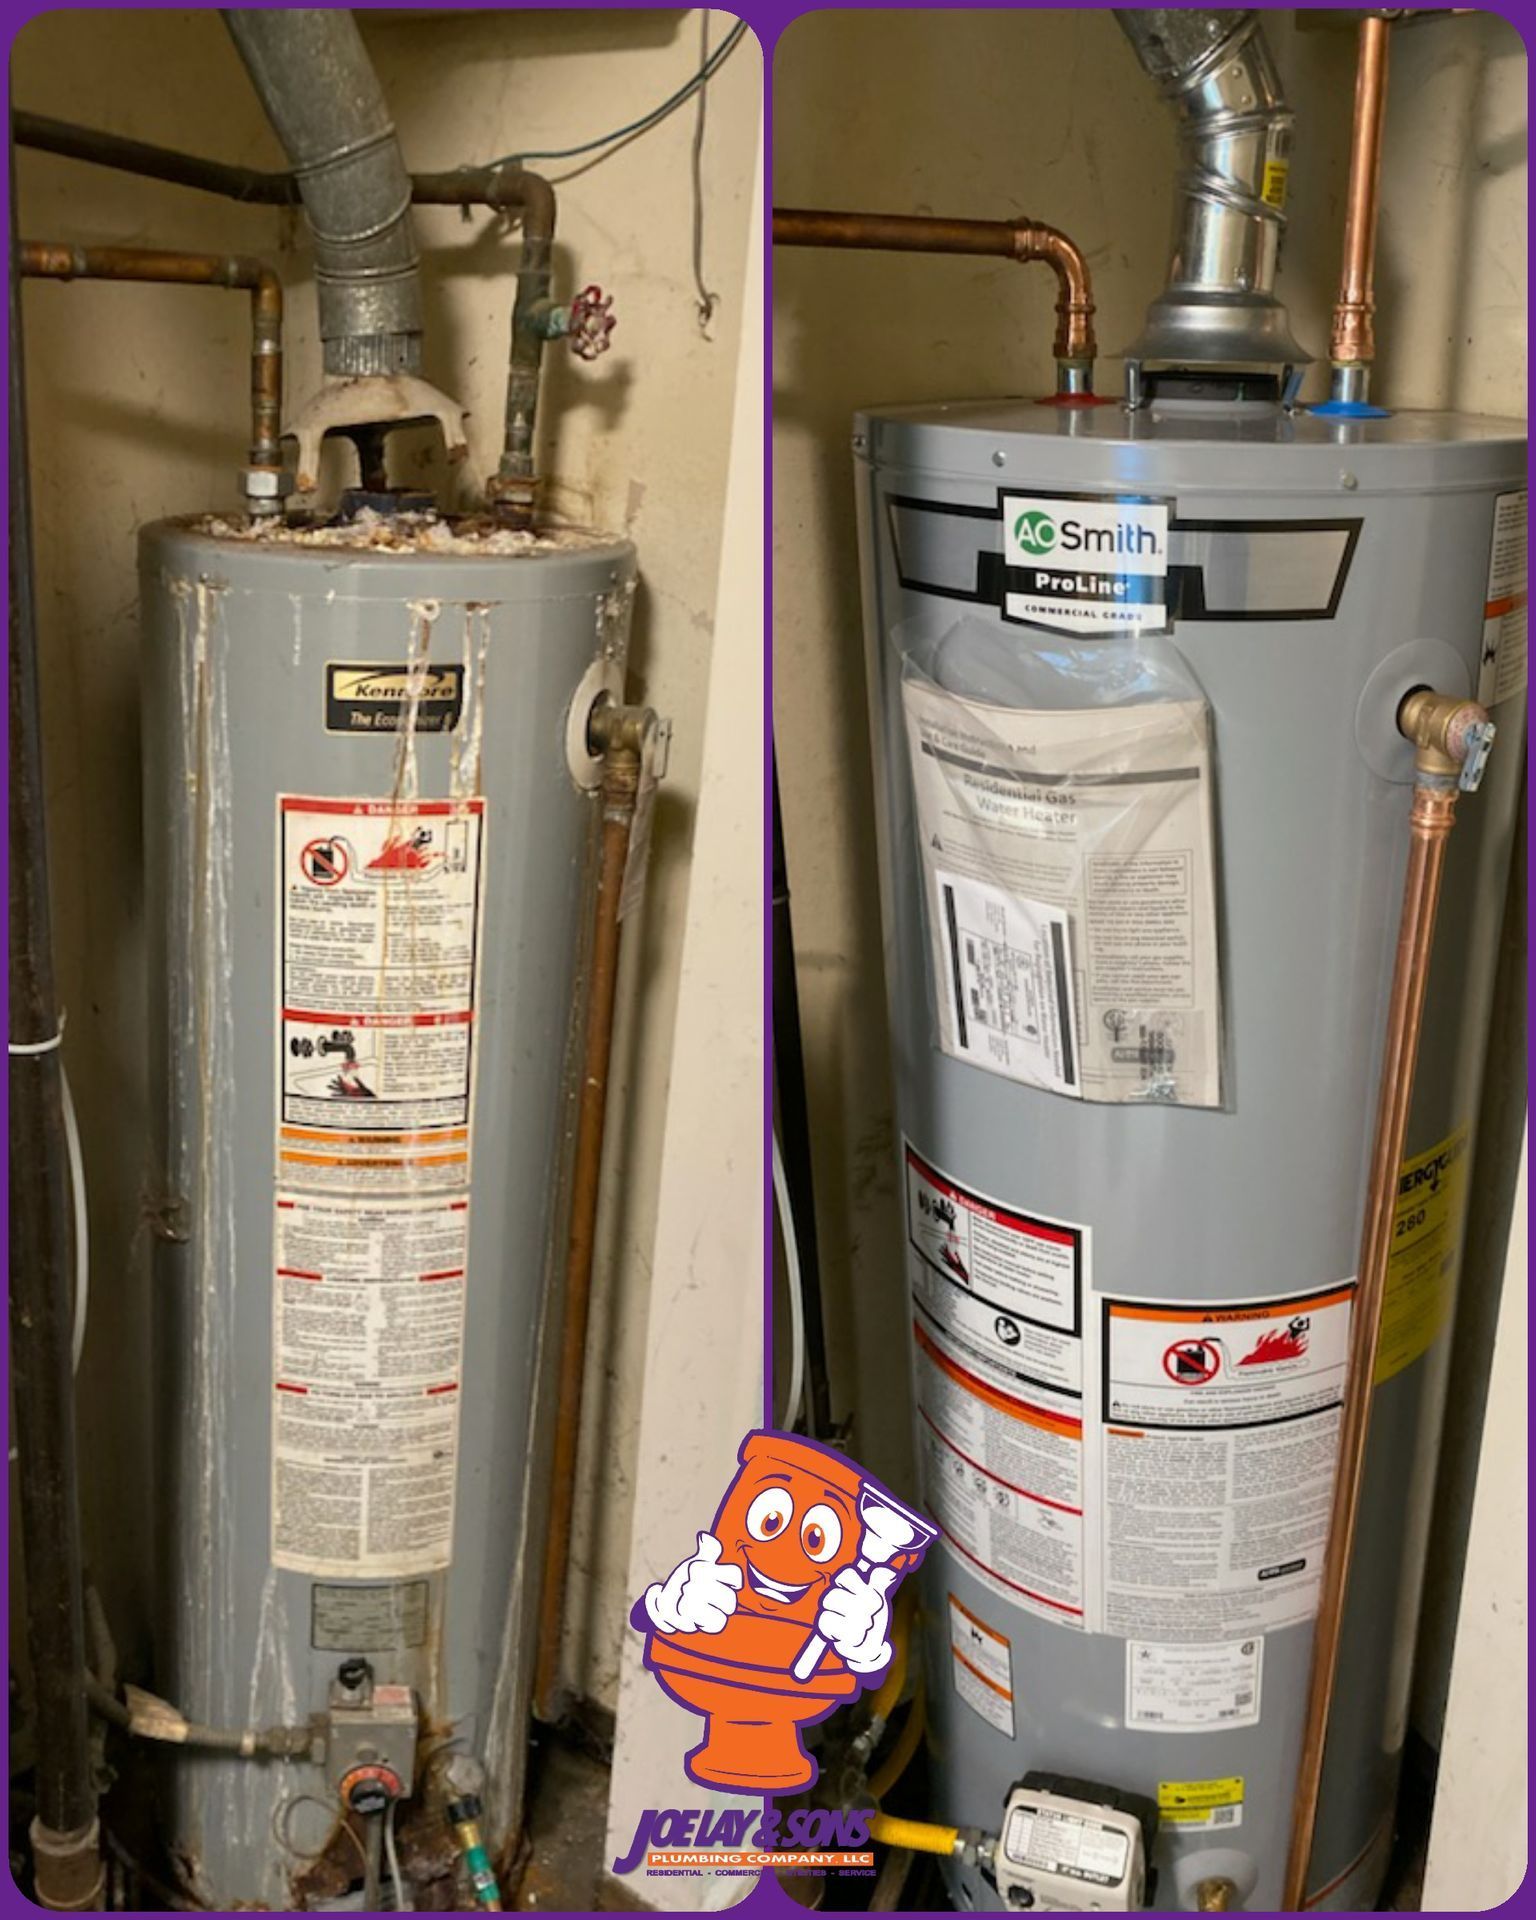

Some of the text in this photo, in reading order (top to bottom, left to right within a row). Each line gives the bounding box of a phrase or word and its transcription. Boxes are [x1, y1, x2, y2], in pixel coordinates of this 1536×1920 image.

[1060, 521, 1157, 555] Smith
[1035, 572, 1128, 595] ProLine
[1024, 603, 1097, 620] COMMERCIAL
[355, 684, 453, 698] Kenore
[351, 711, 371, 727] The
[963, 773, 1077, 805] Residential Gas
[976, 795, 1077, 824] Water Heater
[1396, 1209, 1426, 1238] 280
[1215, 1310, 1270, 1322] WARNING
